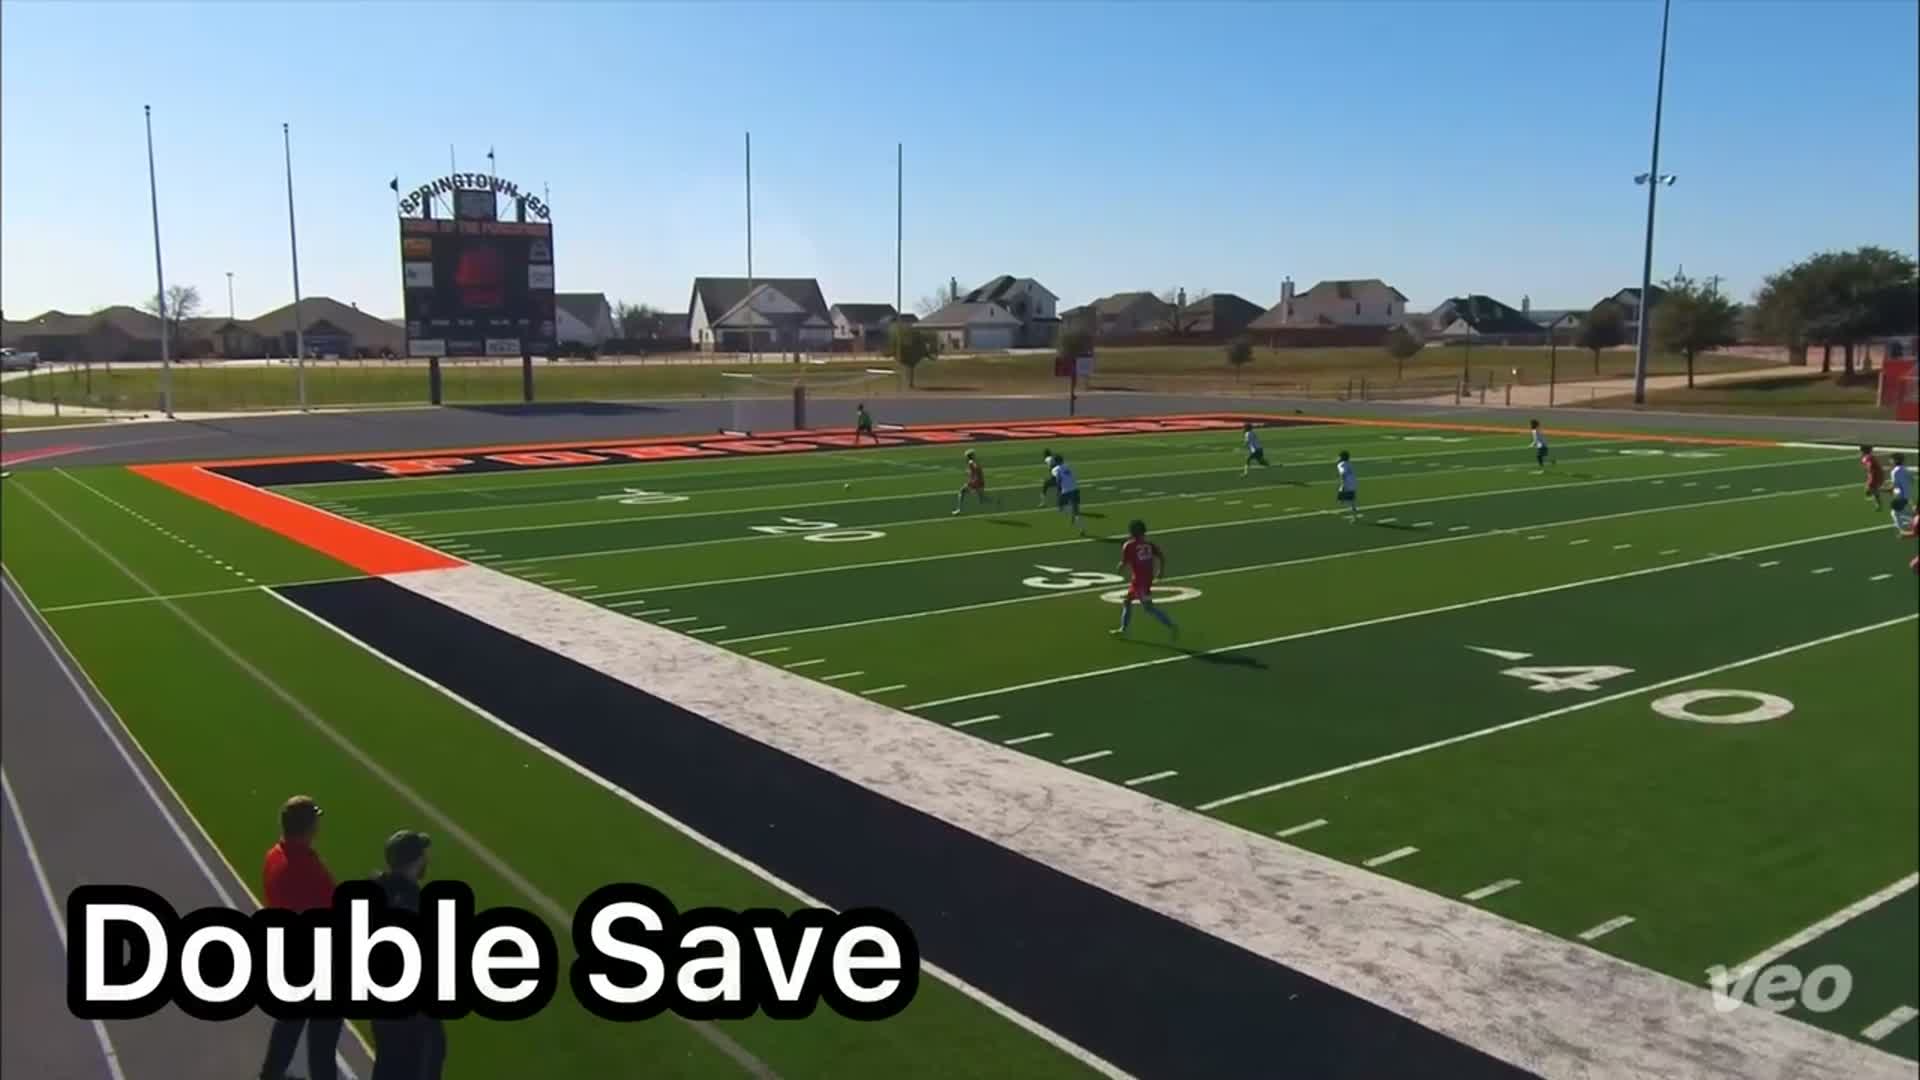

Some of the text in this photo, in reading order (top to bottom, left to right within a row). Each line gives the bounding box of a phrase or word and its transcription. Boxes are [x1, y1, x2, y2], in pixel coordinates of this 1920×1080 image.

[400, 173, 519, 214] SPRINGTOWN
[749, 519, 887, 542] 20
[1022, 572, 1202, 604] 30
[1499, 665, 1794, 723] 40
